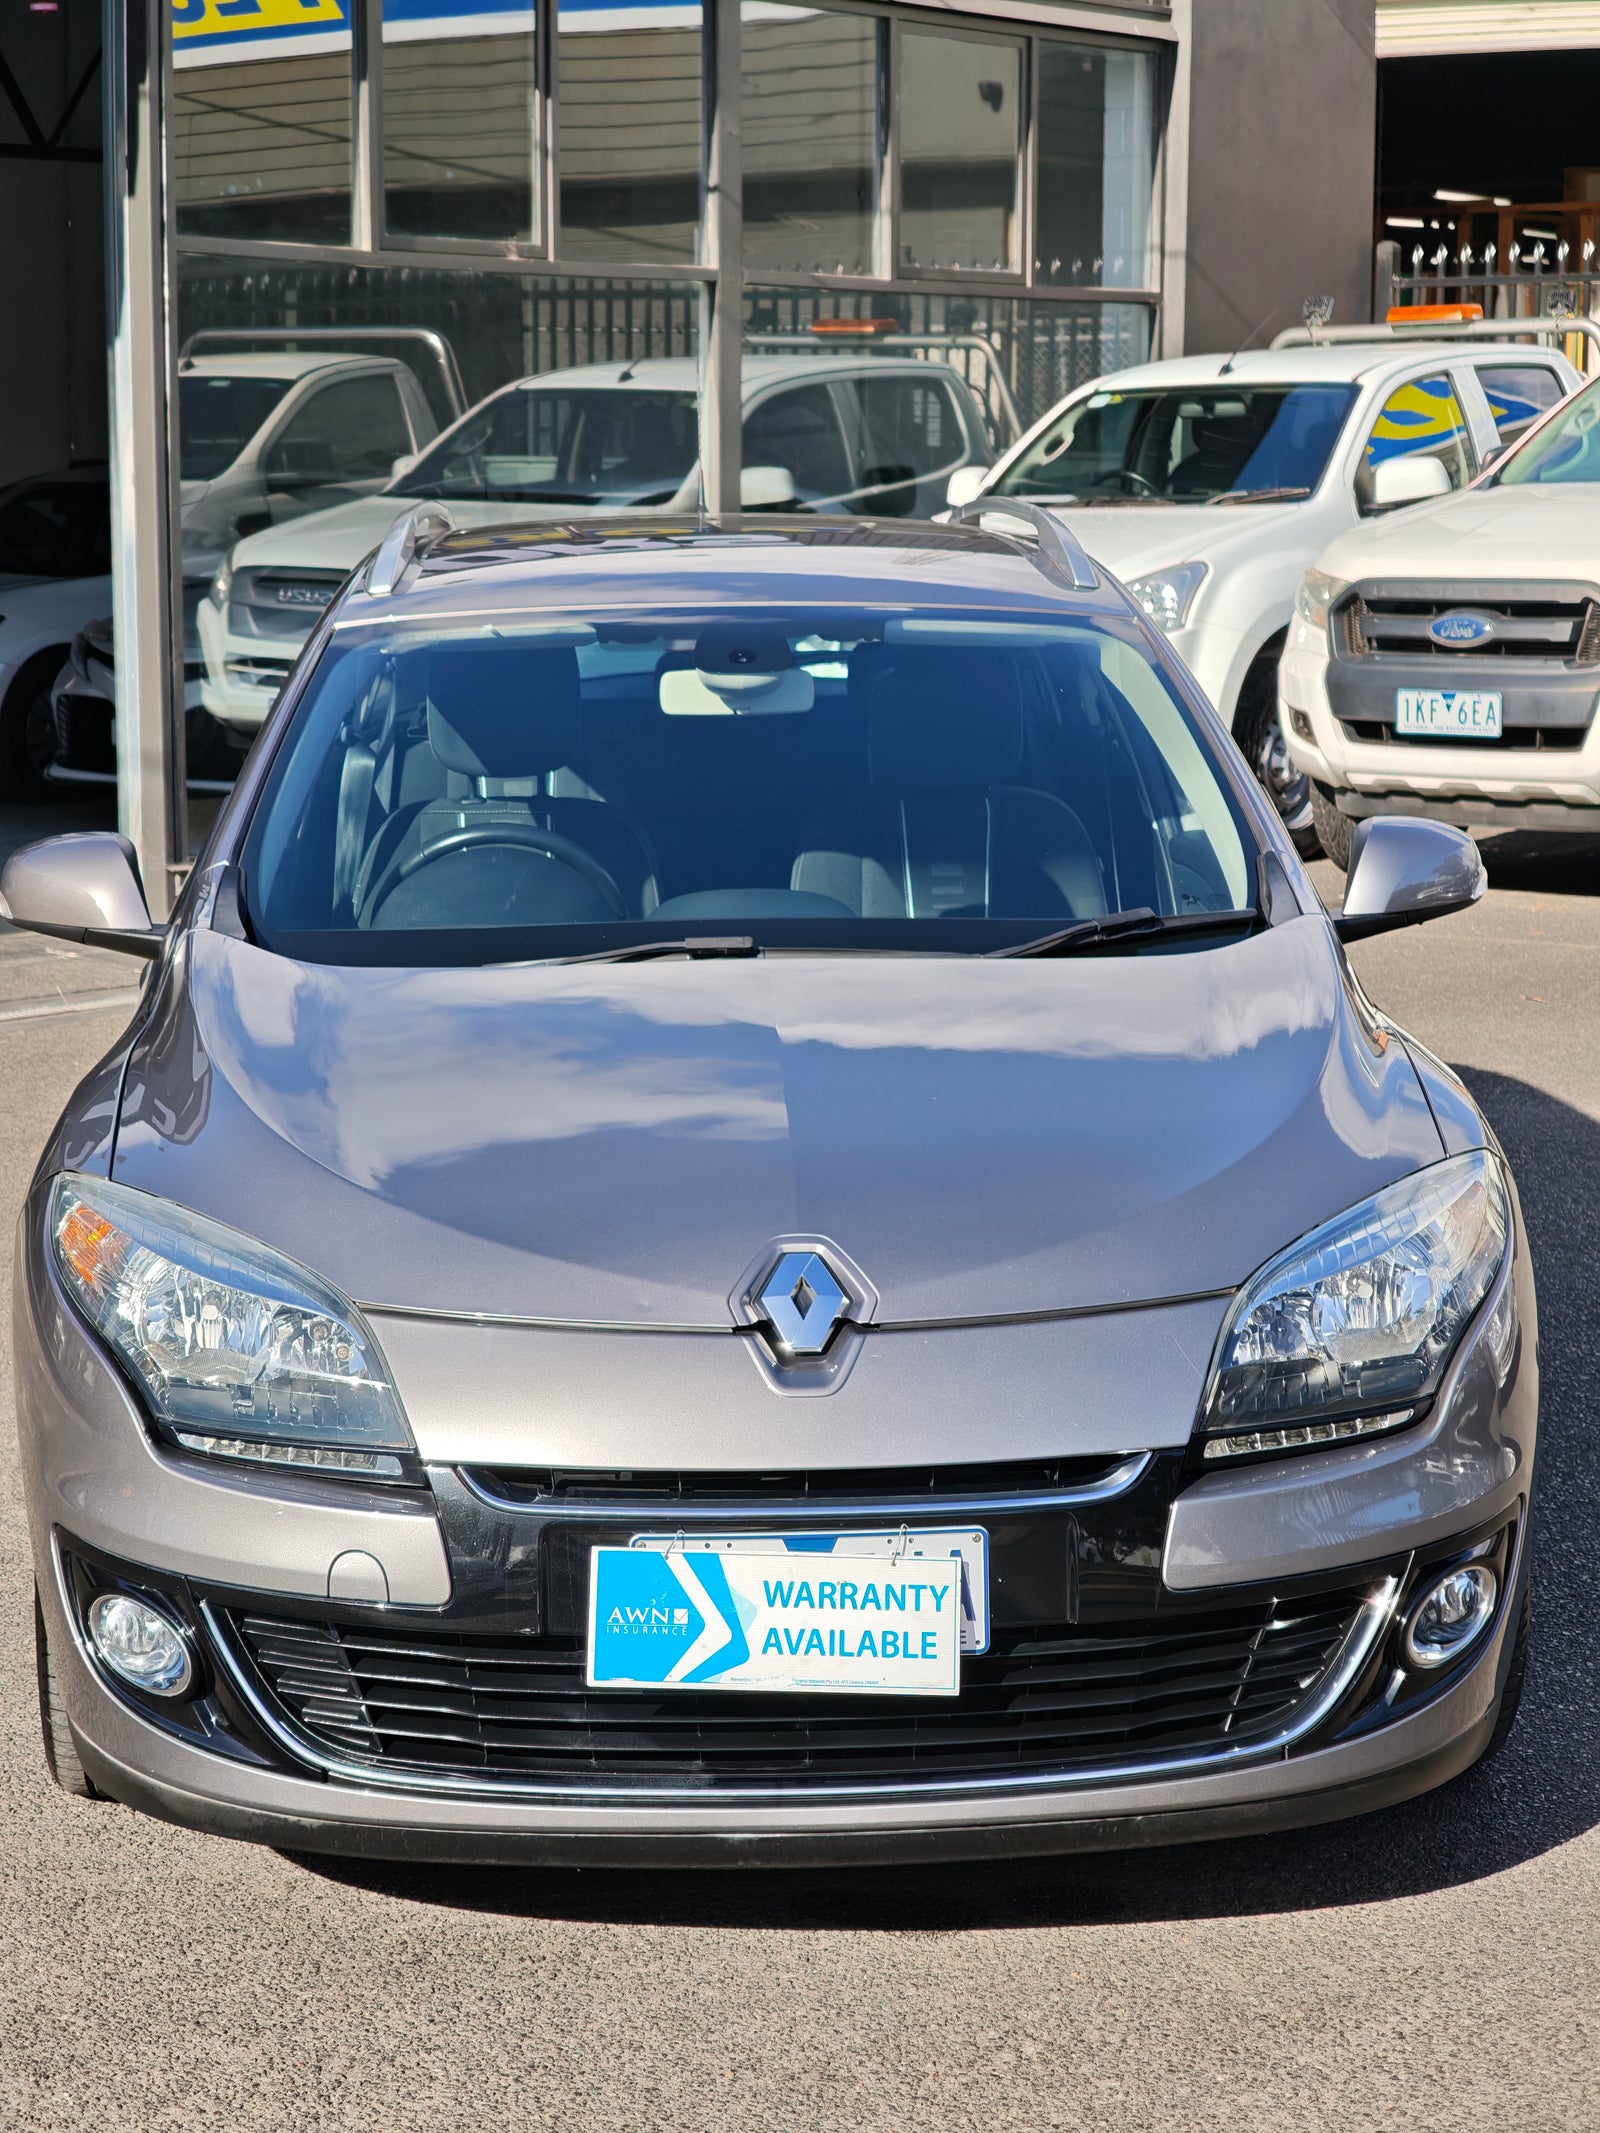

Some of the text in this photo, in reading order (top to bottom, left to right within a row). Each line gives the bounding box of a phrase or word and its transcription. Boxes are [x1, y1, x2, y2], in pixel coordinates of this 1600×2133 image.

[1440, 619, 1476, 638] Ford
[1405, 697, 1497, 726] 1KF 6EA
[763, 1580, 950, 1613] WARRANTY
[606, 1606, 670, 1625] AWN
[606, 1625, 688, 1636] INSURANCE
[761, 1627, 938, 1660] AVAILABLE
